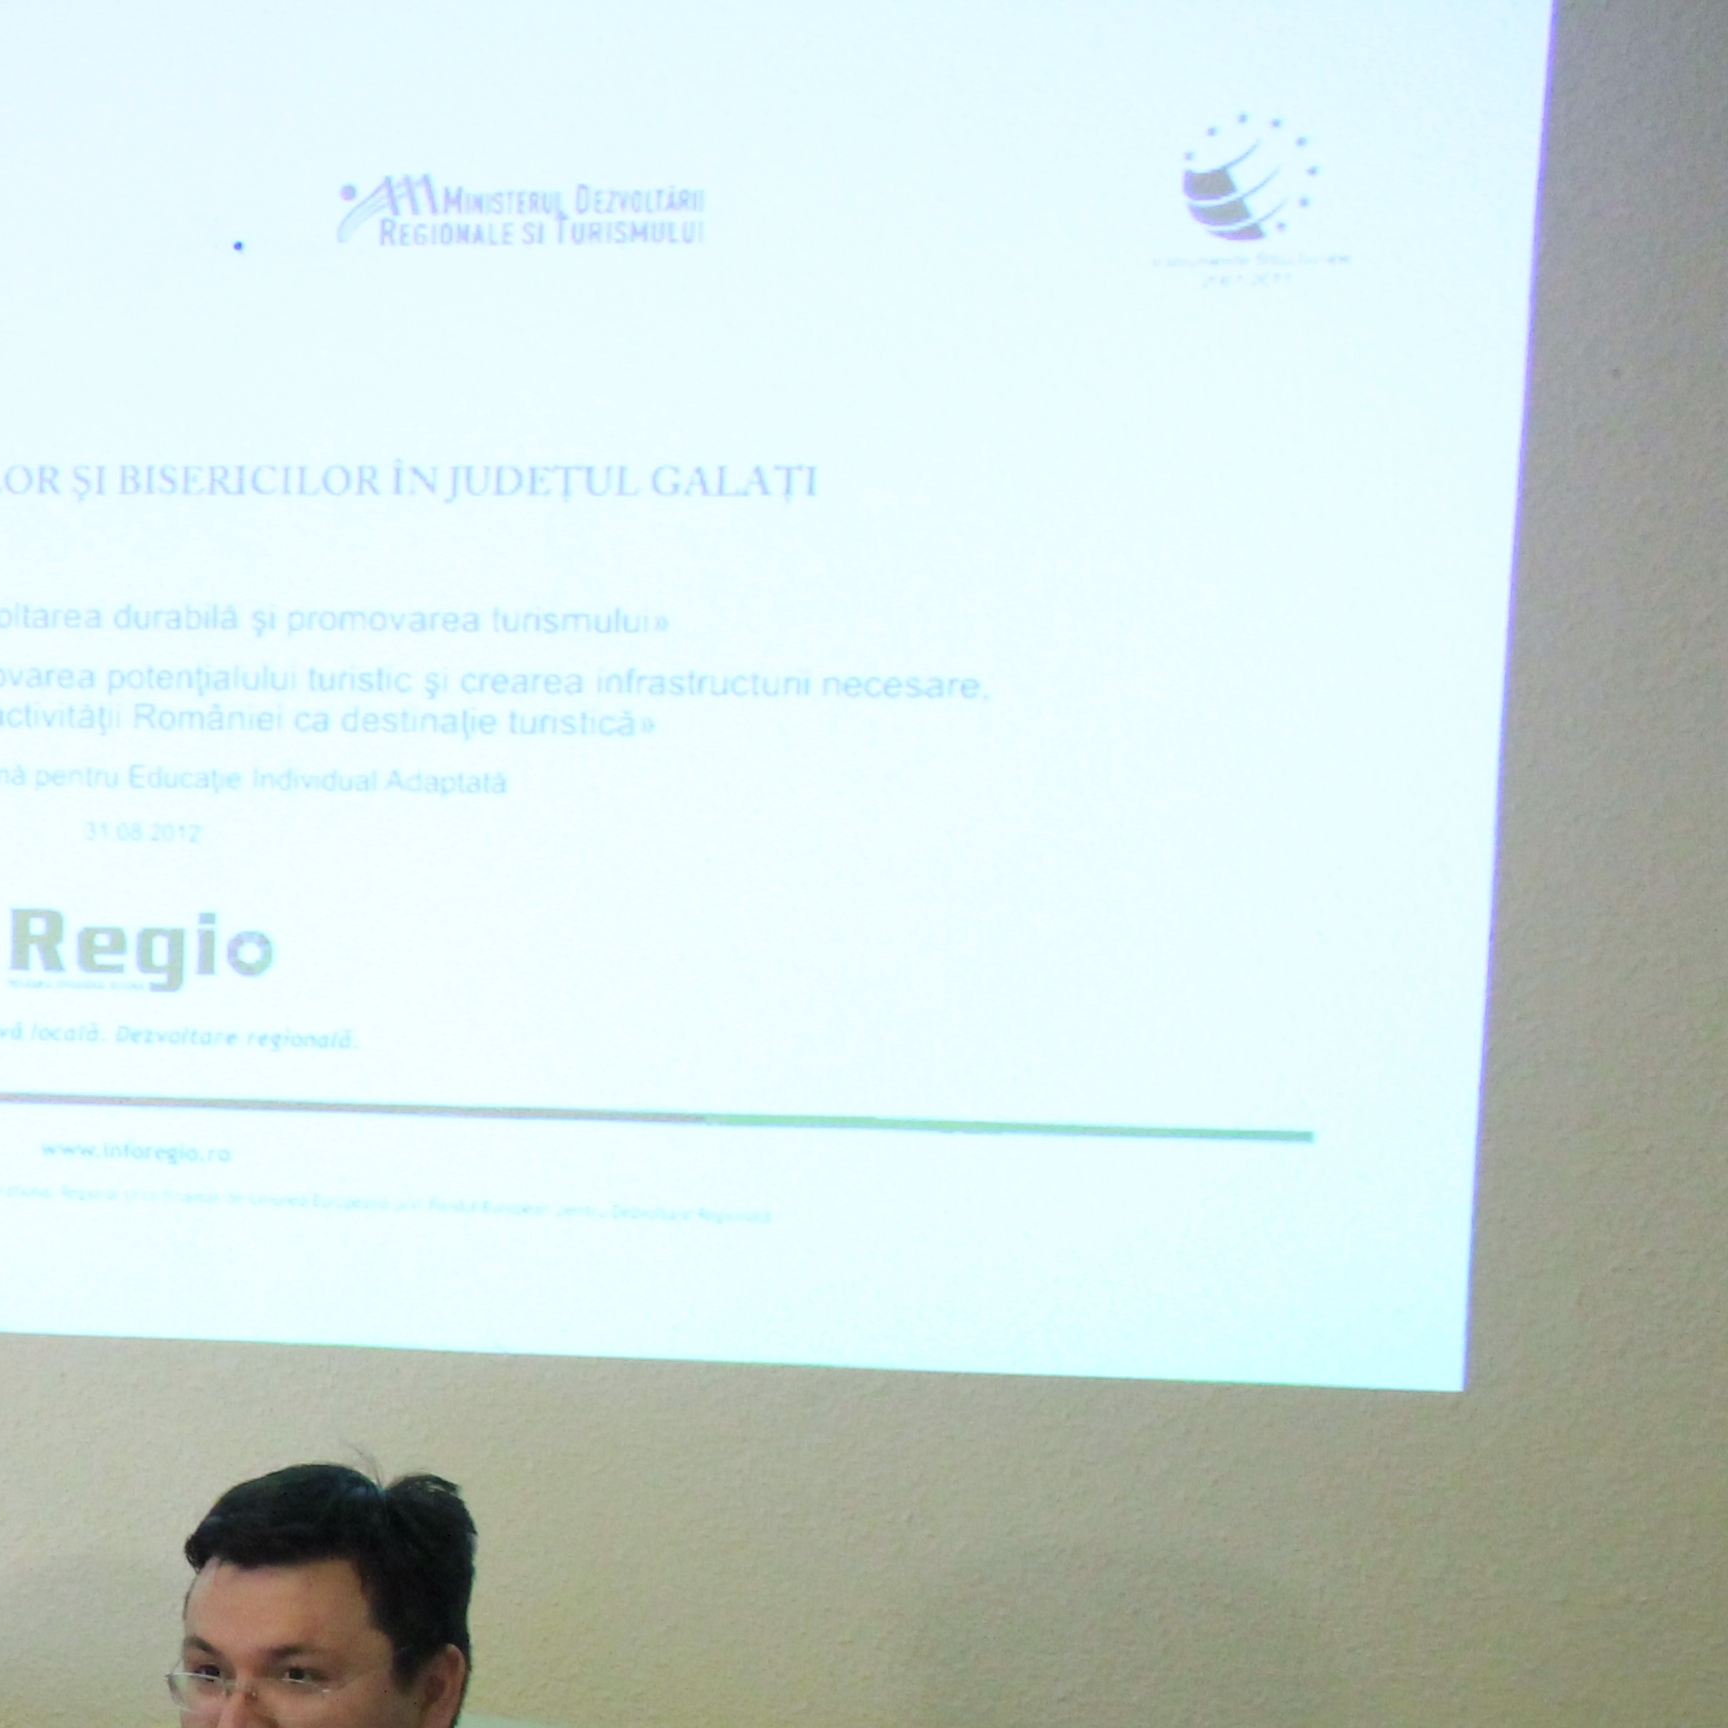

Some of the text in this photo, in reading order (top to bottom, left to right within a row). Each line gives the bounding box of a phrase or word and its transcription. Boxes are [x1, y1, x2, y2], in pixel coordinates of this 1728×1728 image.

[444, 183, 707, 214] MINISTERUL DEZVOLTĂRII
[380, 217, 515, 247] REGIONALE
[556, 212, 707, 246] TURISMULUI
[119, 462, 383, 497] BISERICILOR
[392, 457, 440, 496] ÎN
[113, 603, 241, 631] durabilă
[287, 609, 483, 637] promovarea
[307, 666, 413, 695] turistic
[459, 670, 586, 697] crearea
[133, 701, 285, 732] României
[292, 709, 333, 734] ca
[34, 766, 121, 791] pentru
[252, 767, 380, 793] Individual
[8, 906, 275, 993] Regio
[115, 1024, 238, 1047] Dezvoltare
